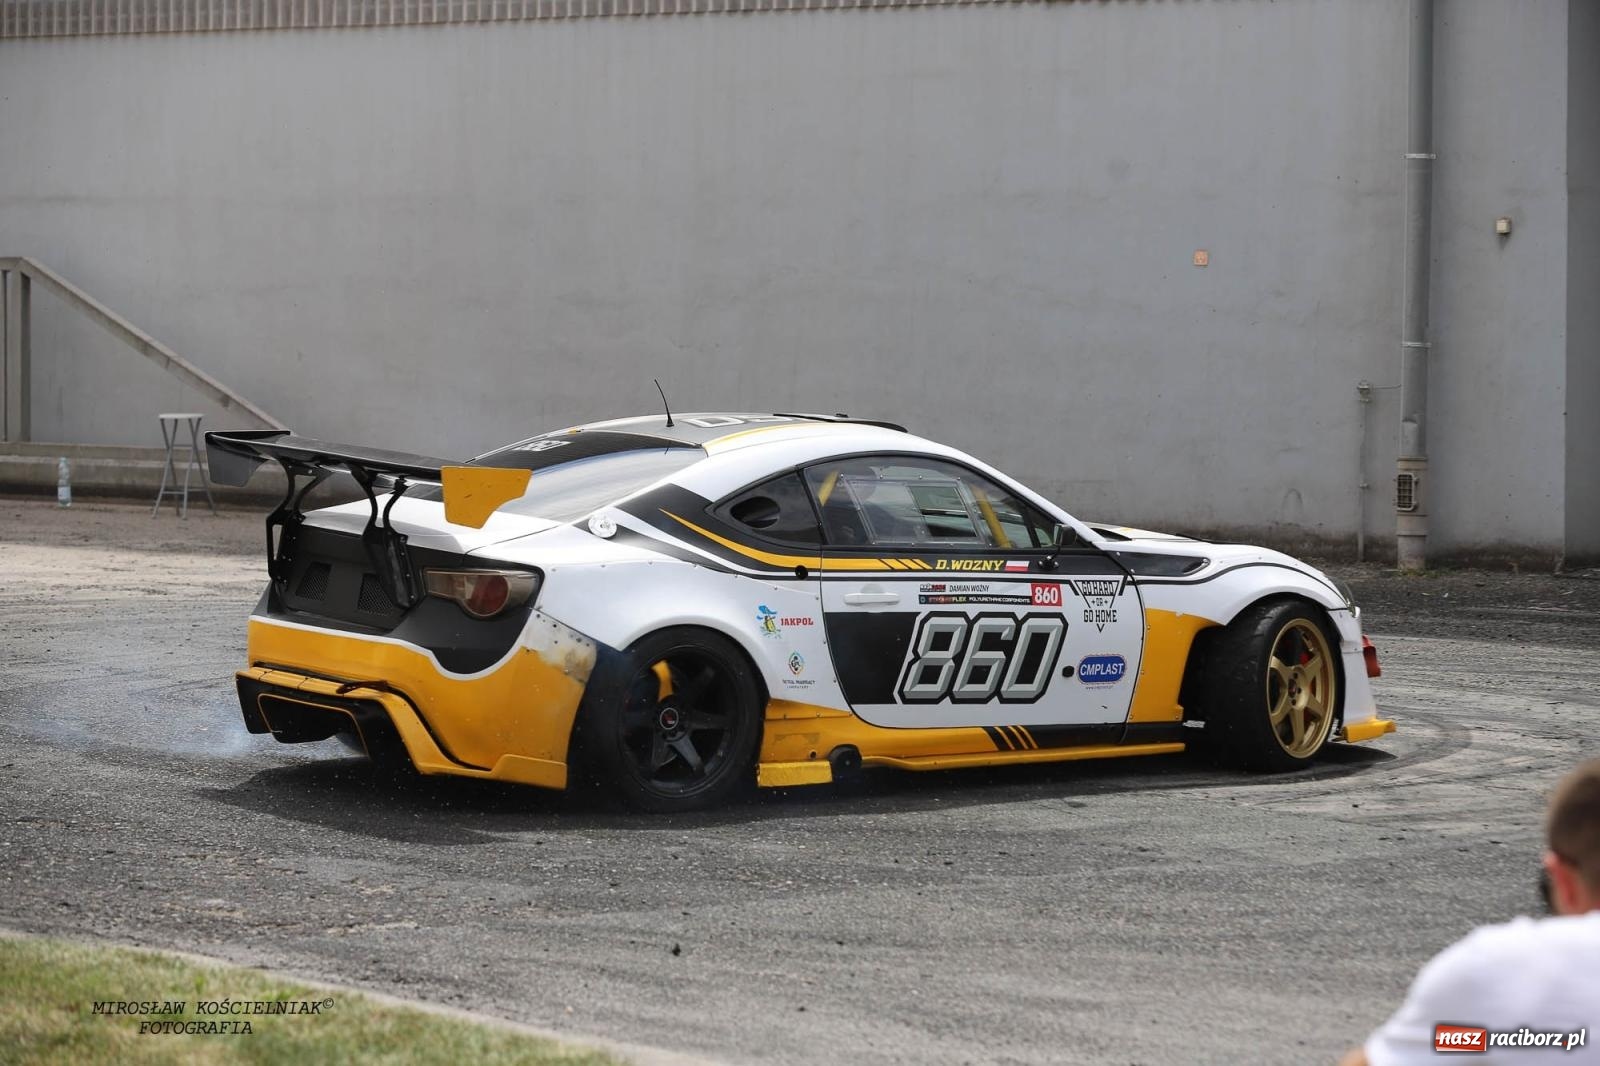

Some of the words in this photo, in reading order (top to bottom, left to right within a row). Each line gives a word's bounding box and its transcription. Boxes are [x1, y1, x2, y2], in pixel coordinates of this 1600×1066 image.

[949, 584, 970, 592] DAMIAN
[1082, 581, 1092, 595] GO
[1092, 581, 1115, 595] HARD
[1035, 586, 1058, 604] 860
[1096, 598, 1103, 606] OR
[1084, 610, 1093, 622] GO
[1095, 610, 1117, 622] HOME
[895, 612, 1068, 704] 860
[1080, 663, 1124, 676] CMPLAST
